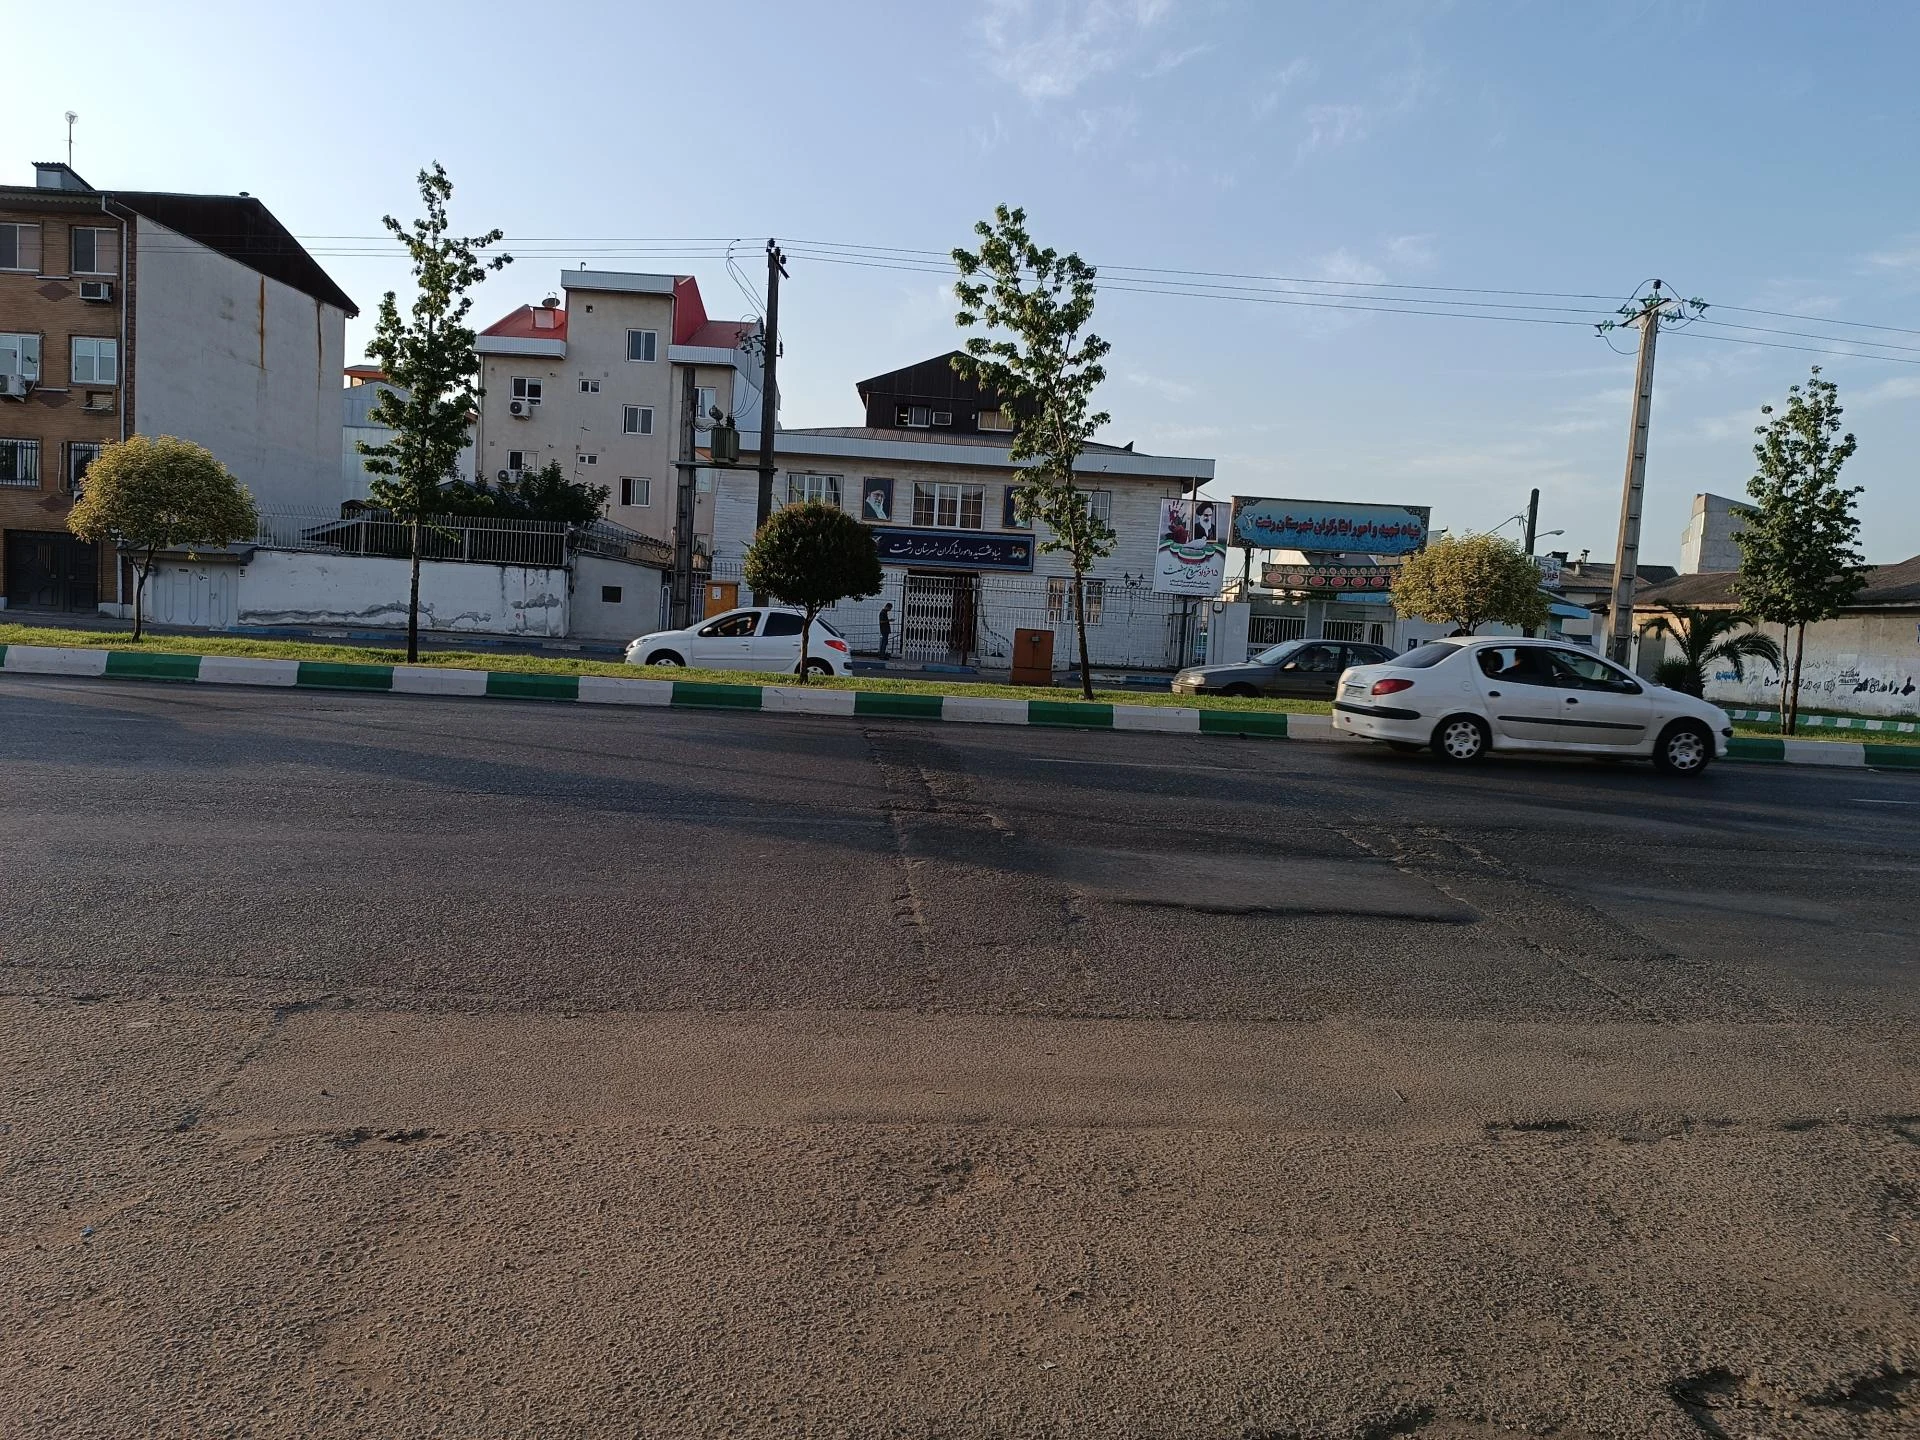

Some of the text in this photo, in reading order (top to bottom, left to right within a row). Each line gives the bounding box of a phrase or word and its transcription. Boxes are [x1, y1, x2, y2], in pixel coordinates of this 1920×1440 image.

[1256, 514, 1276, 534] رشت
[1276, 515, 1313, 533] شهرستان
[1314, 517, 1352, 536] ایثارگران
[1351, 520, 1371, 537] امور
[1379, 522, 1400, 537] شهید
[1401, 522, 1421, 540] بنیاد
[889, 540, 914, 554] رشت
[915, 542, 938, 556] شهرستان
[937, 540, 961, 558] ایثارگران
[973, 545, 992, 559] شهید
[991, 547, 1001, 561] بنیاد
